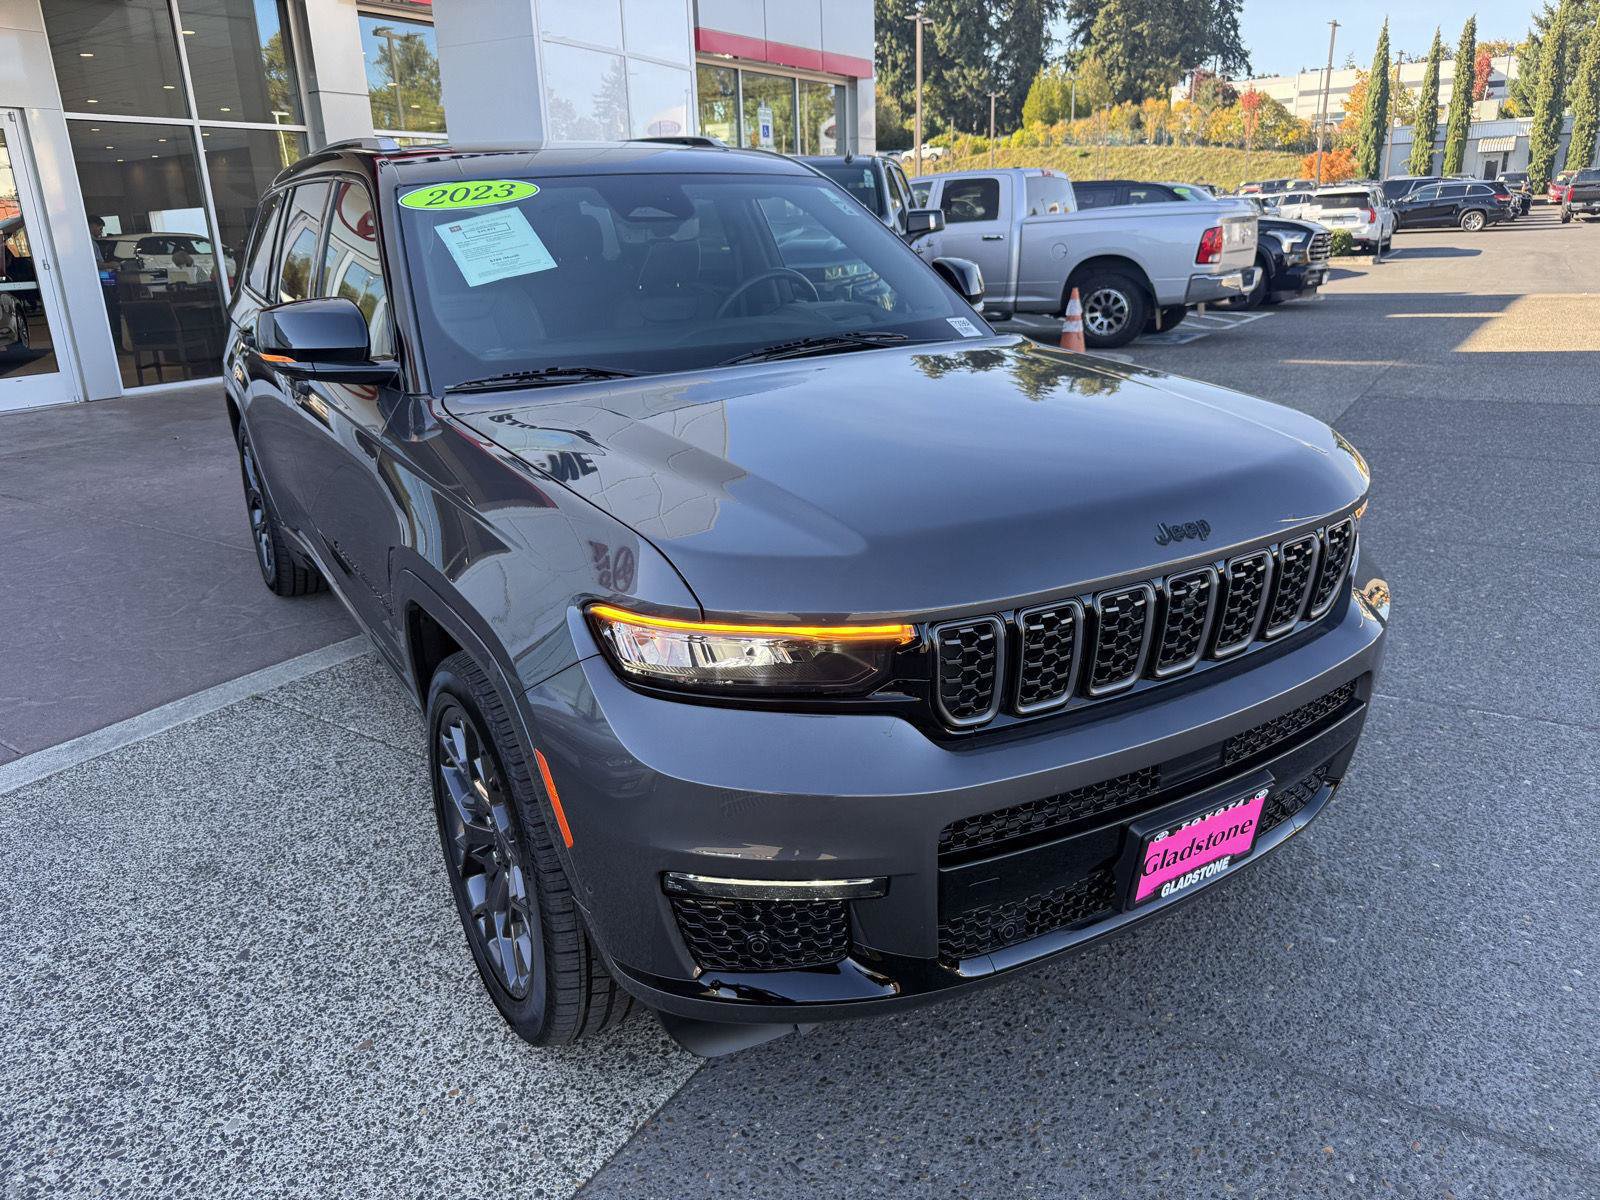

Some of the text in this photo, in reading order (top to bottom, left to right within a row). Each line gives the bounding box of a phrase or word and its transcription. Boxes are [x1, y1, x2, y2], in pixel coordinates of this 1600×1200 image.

[424, 183, 517, 207] 2023
[1154, 519, 1211, 546] Jeep
[1181, 799, 1245, 830] TOYOTA
[1142, 819, 1253, 877] Gladstone
[1161, 855, 1231, 898] GLADSTONE
